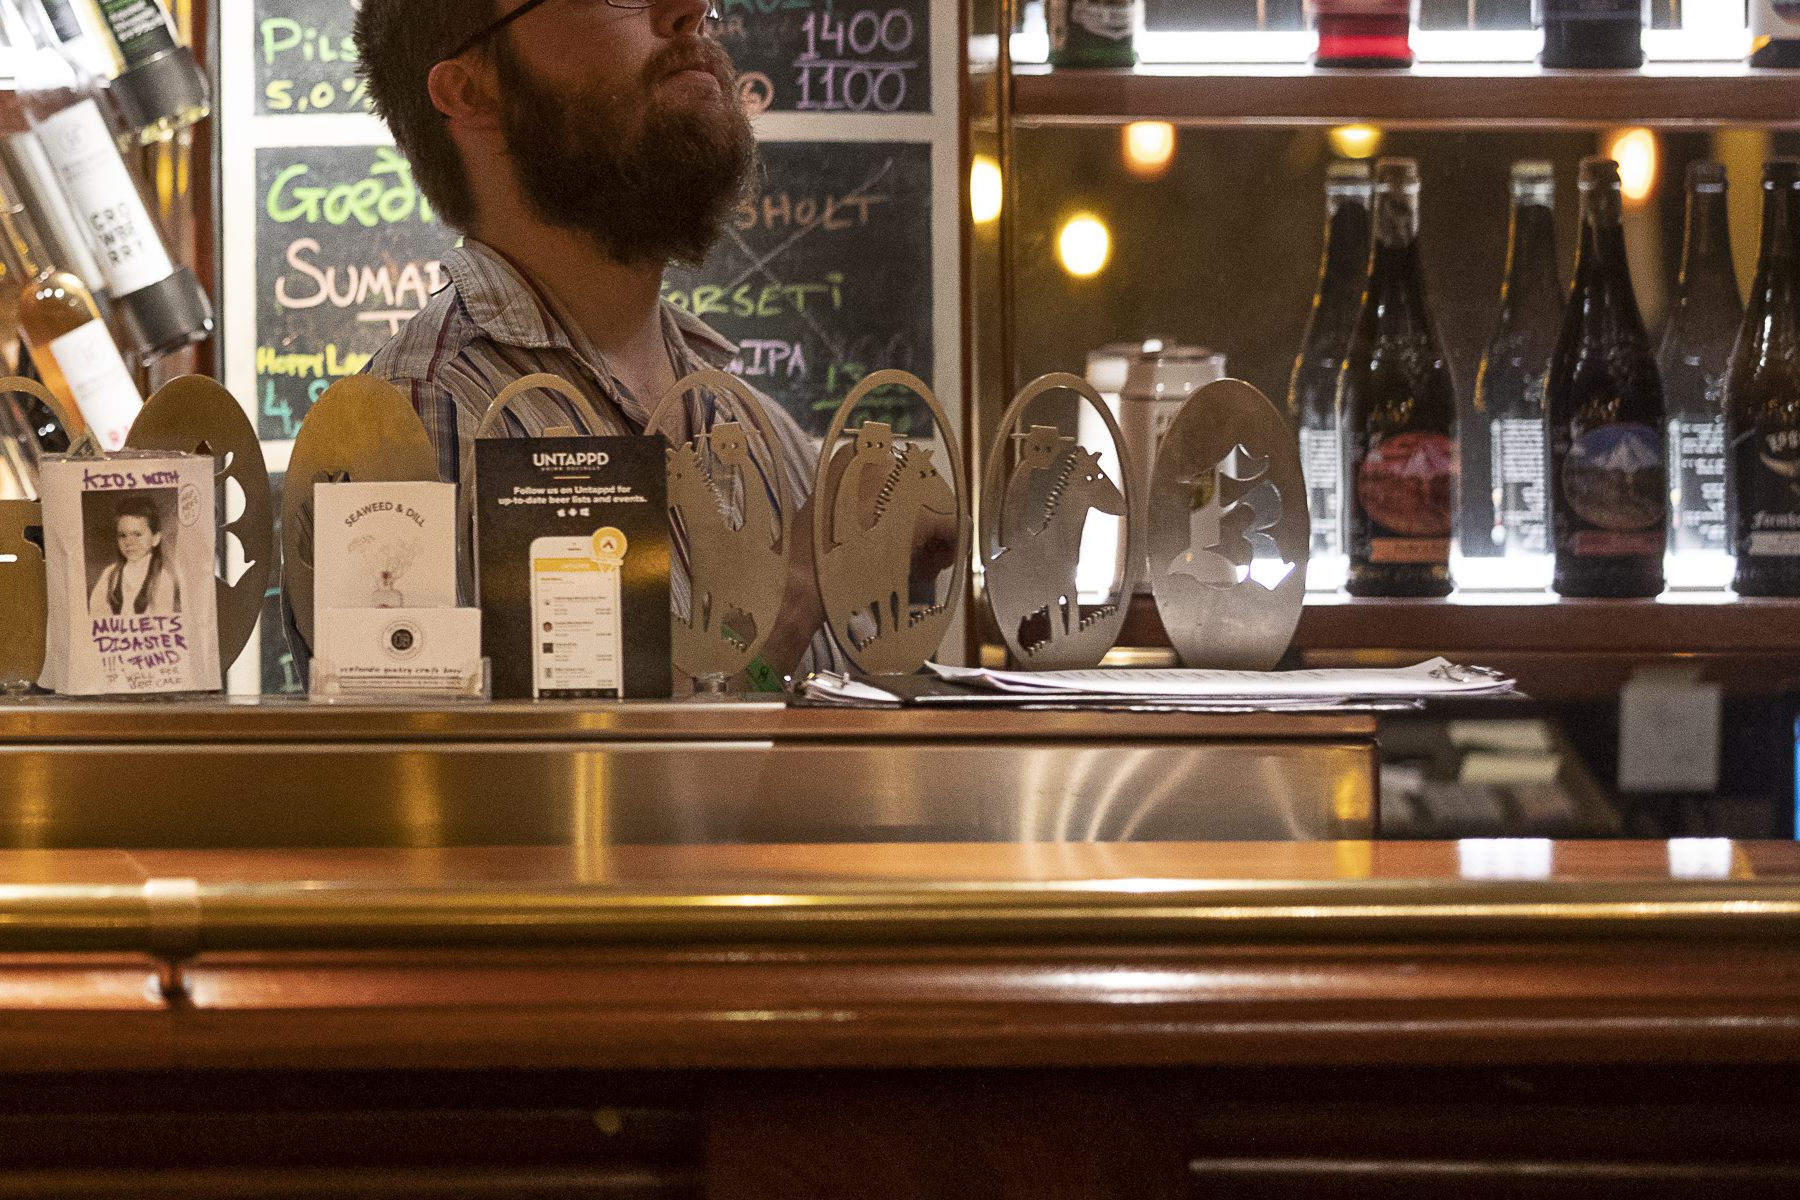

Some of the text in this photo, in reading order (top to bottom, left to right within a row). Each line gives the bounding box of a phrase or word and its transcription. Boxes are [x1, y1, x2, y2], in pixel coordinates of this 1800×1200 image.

[801, 8, 914, 58] 1400
[796, 65, 907, 111] 1100
[532, 451, 610, 467] UNTAPPD
[82, 468, 179, 490] KIDS WITH
[498, 496, 547, 506] up-to-date
[548, 495, 571, 504] beer
[572, 494, 591, 504] lists
[593, 494, 612, 503] and
[513, 485, 632, 496] Follow us on Untappd for
[345, 501, 427, 528] SEAWEED & DILL
[92, 615, 183, 637] MULLETS
[93, 633, 188, 653] DISASTER
[128, 650, 181, 670] FUND
